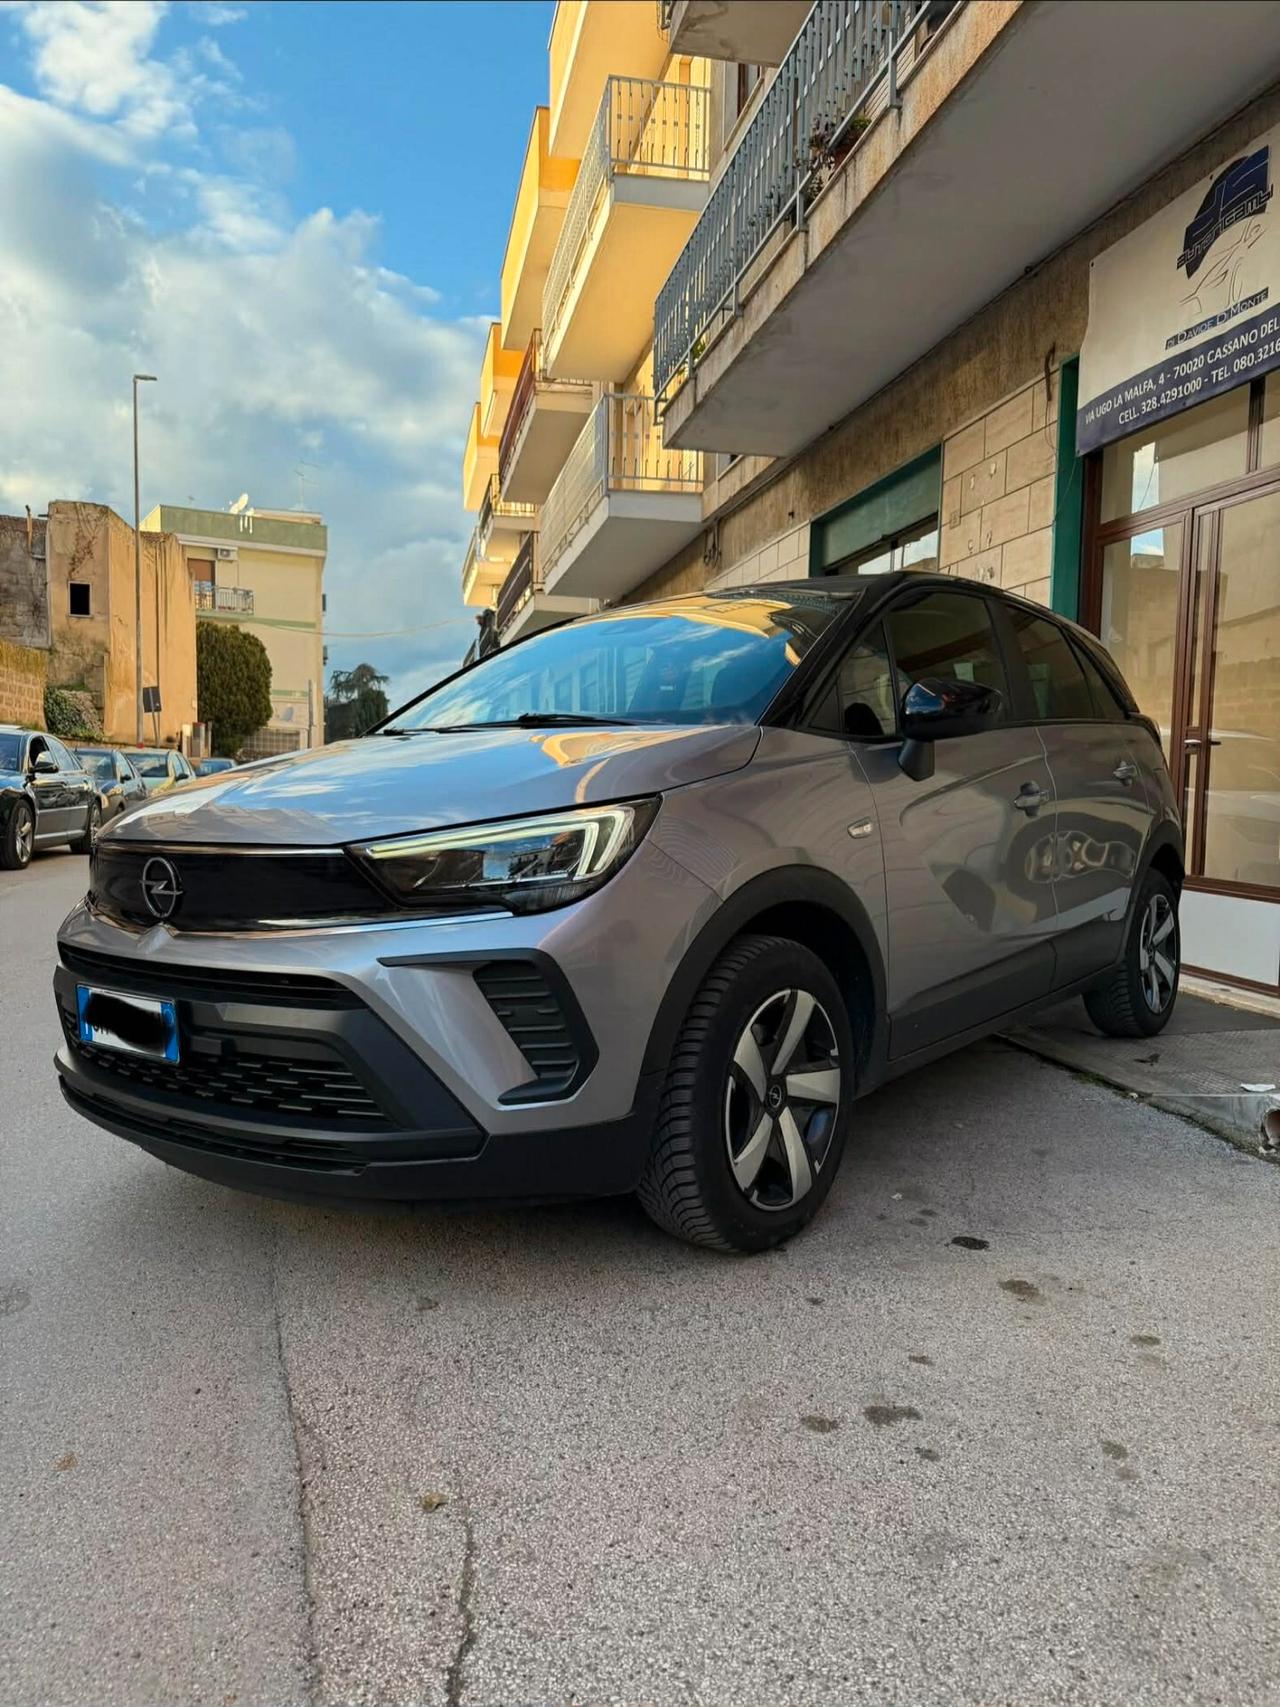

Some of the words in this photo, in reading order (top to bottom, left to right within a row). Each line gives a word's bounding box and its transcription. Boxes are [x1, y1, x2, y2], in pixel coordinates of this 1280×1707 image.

[1085, 410, 1095, 424] VIA
[1096, 400, 1112, 418] UGO
[1113, 394, 1123, 408] LA
[1124, 378, 1156, 402] MALFA,
[1158, 372, 1165, 384] 4
[1173, 354, 1204, 379] 70020
[1207, 329, 1258, 364] CASSANO
[1260, 317, 1279, 338] DEL
[1118, 407, 1139, 424] CELL.
[1141, 377, 1202, 415] 328.4291000
[1211, 365, 1231, 383] TEL.
[1233, 338, 1280, 373] 080.3216
